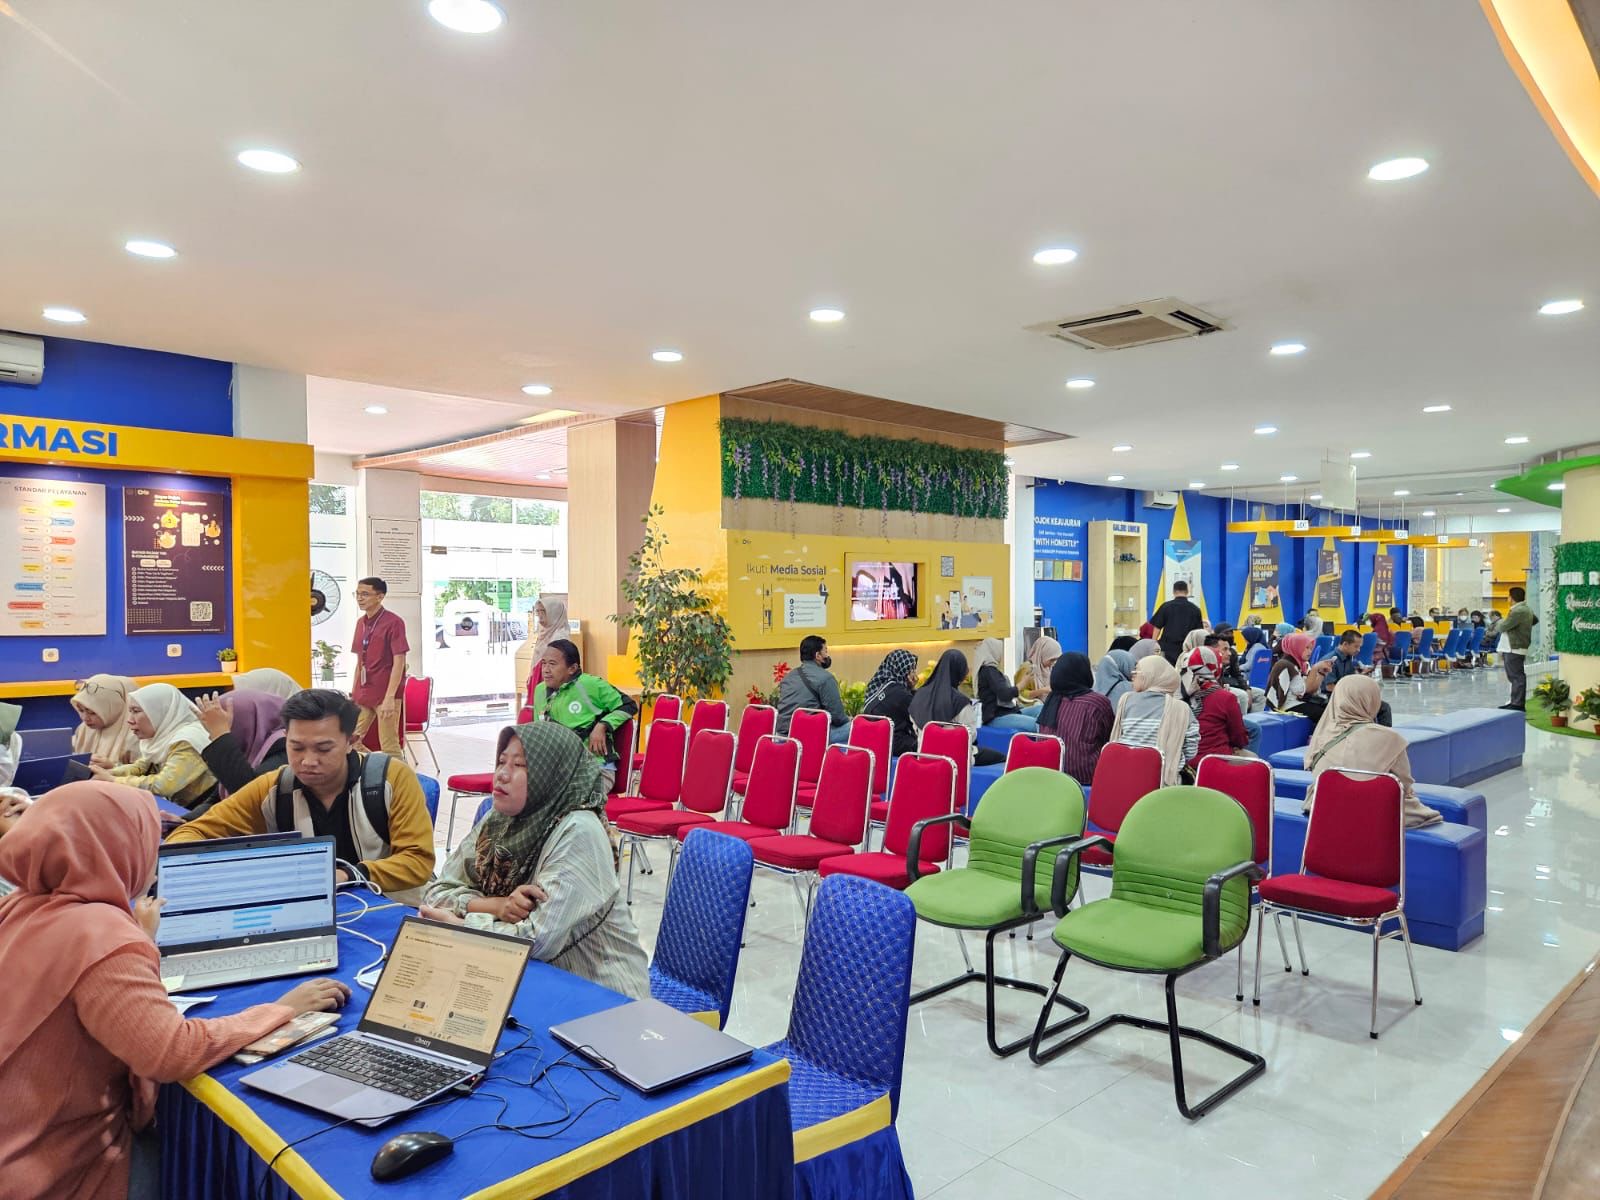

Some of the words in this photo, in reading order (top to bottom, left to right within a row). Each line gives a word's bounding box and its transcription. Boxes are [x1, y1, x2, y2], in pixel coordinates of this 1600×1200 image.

[746, 562, 768, 574] Ikuti
[770, 564, 799, 575] Media
[801, 565, 827, 575] Sosial
